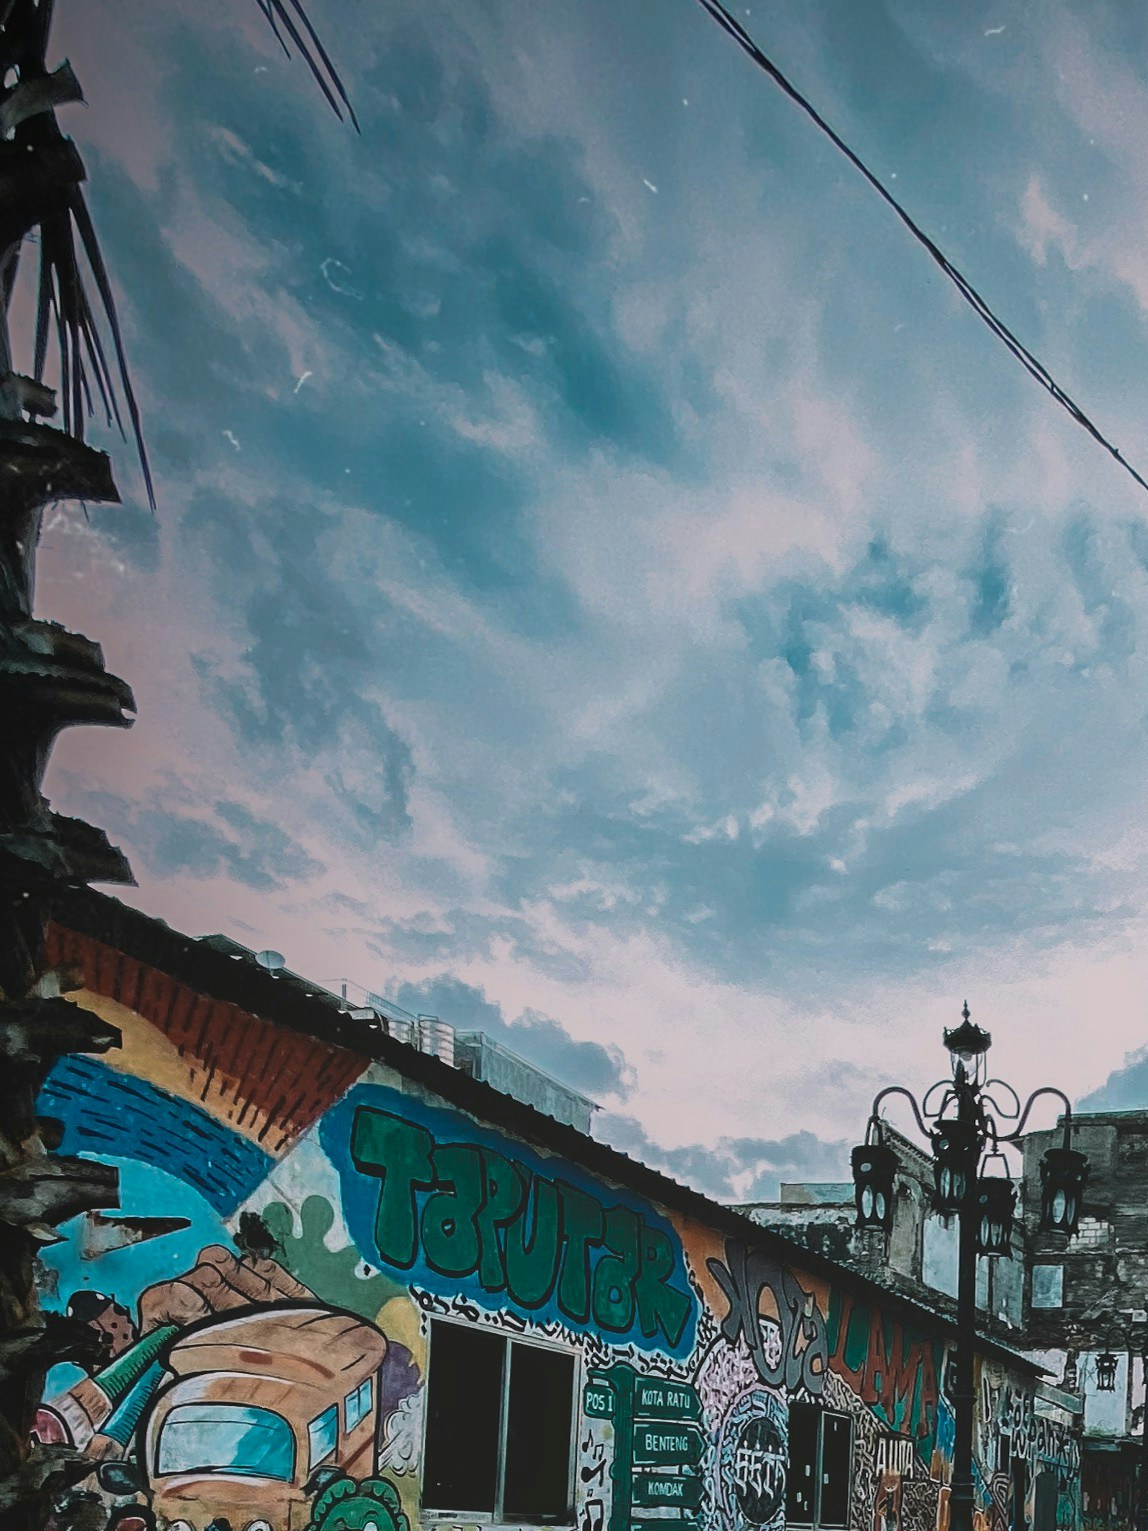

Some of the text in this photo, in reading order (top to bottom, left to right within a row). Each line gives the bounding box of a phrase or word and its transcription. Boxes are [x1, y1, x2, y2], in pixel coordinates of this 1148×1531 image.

[586, 1391, 606, 1411] POS
[641, 1388, 691, 1409] KOTA RATU
[644, 1433, 688, 1452] BENTENG
[648, 1481, 684, 1497] KOMDAK
